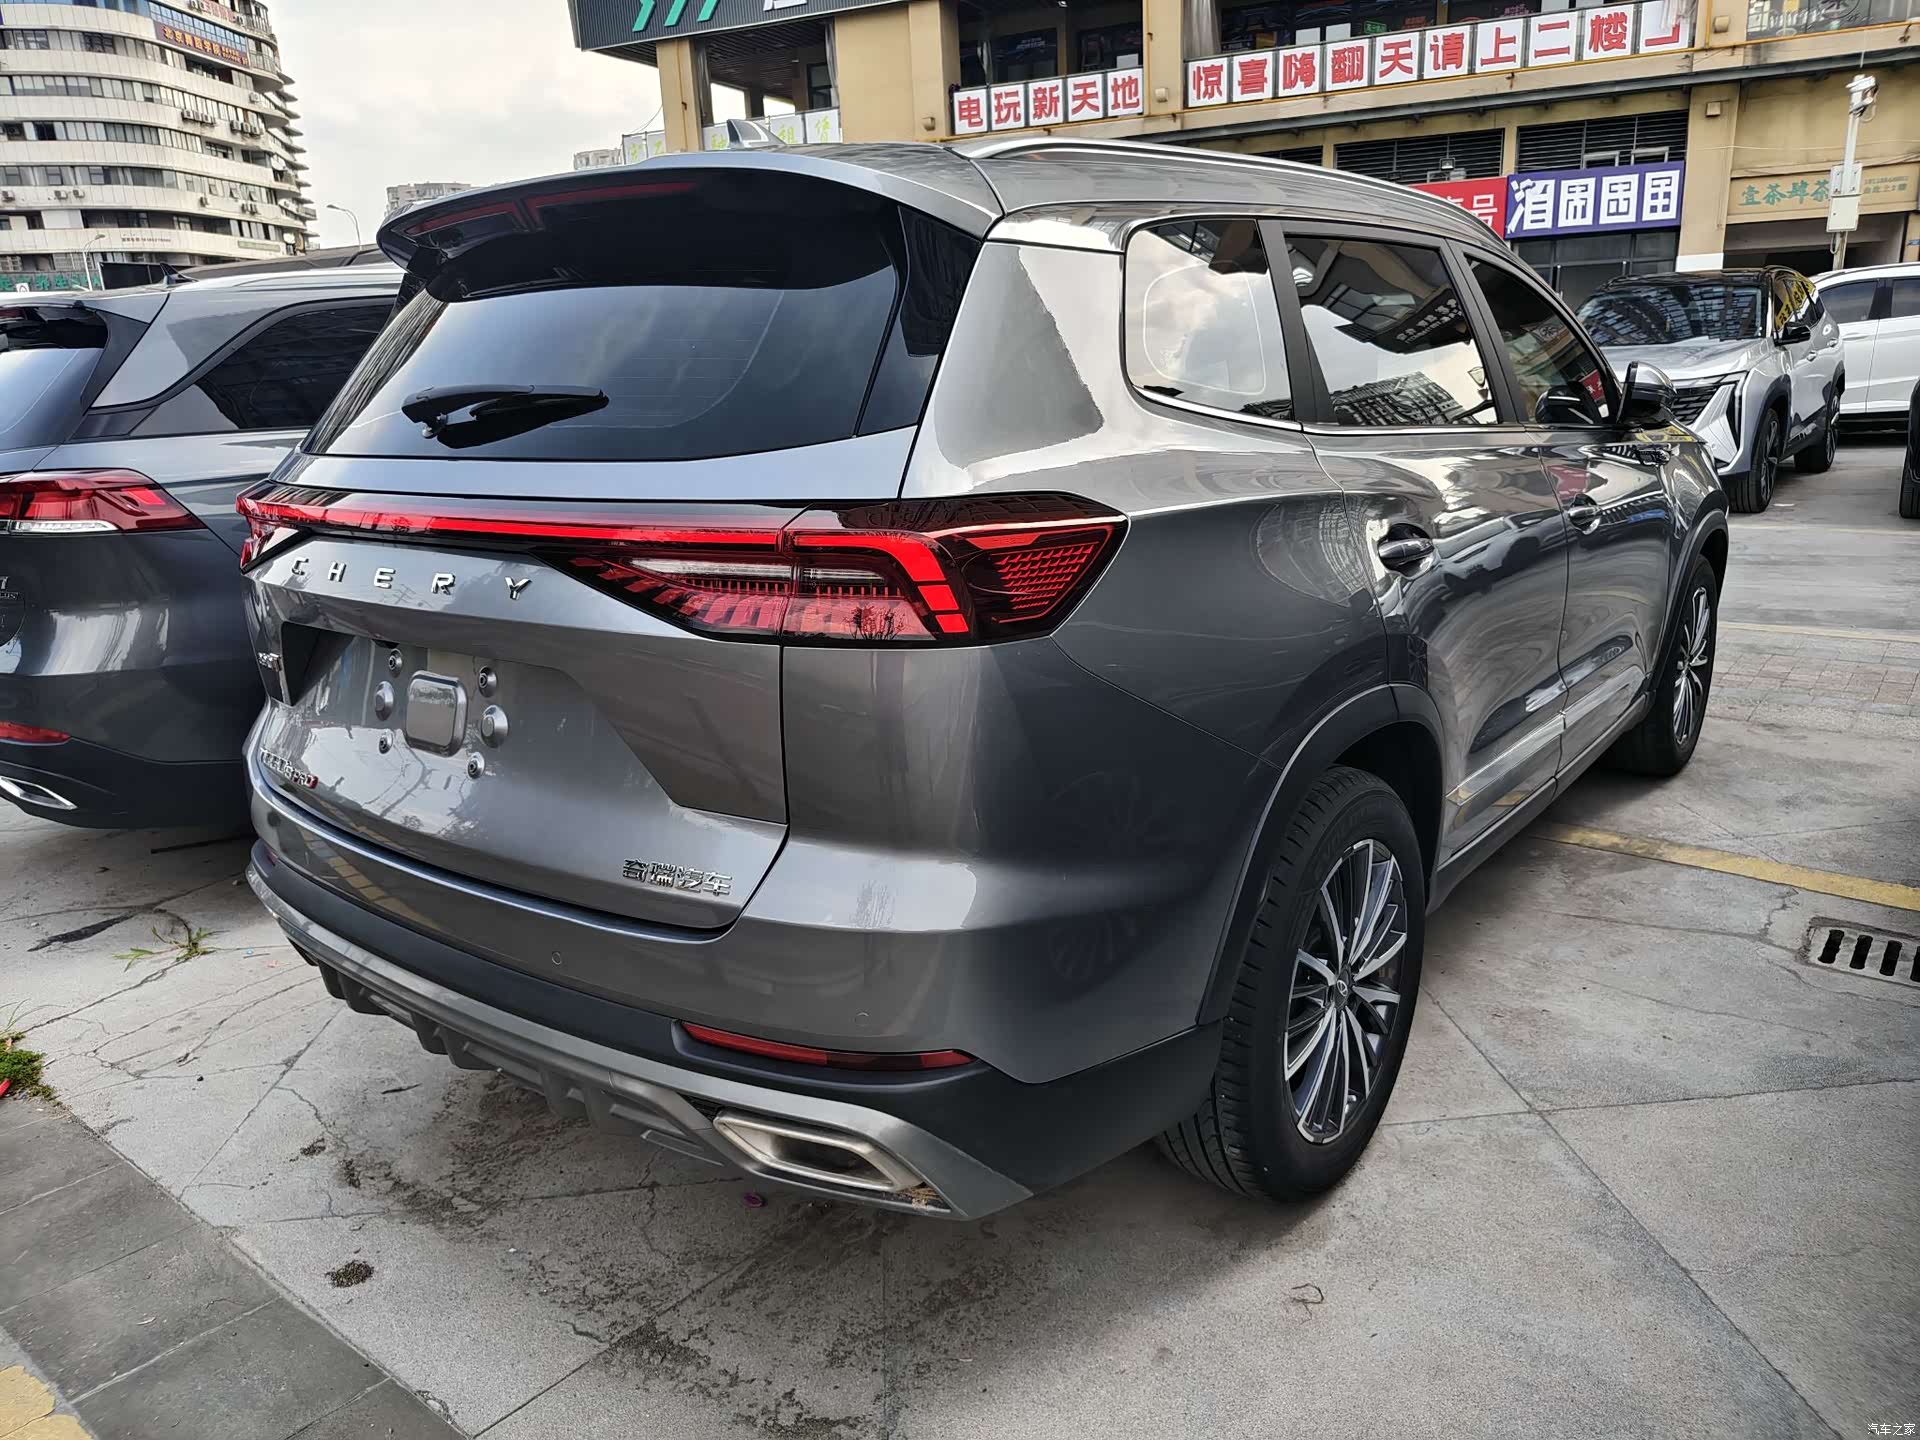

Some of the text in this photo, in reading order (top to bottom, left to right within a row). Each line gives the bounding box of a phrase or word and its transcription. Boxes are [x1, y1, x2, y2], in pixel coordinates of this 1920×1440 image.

[1193, 12, 1628, 98] 惊喜嗨翻天请上二楼
[957, 75, 1140, 128] 电玩新天地
[291, 556, 532, 600] CHERY
[622, 858, 733, 896] 奇瑞汽车
